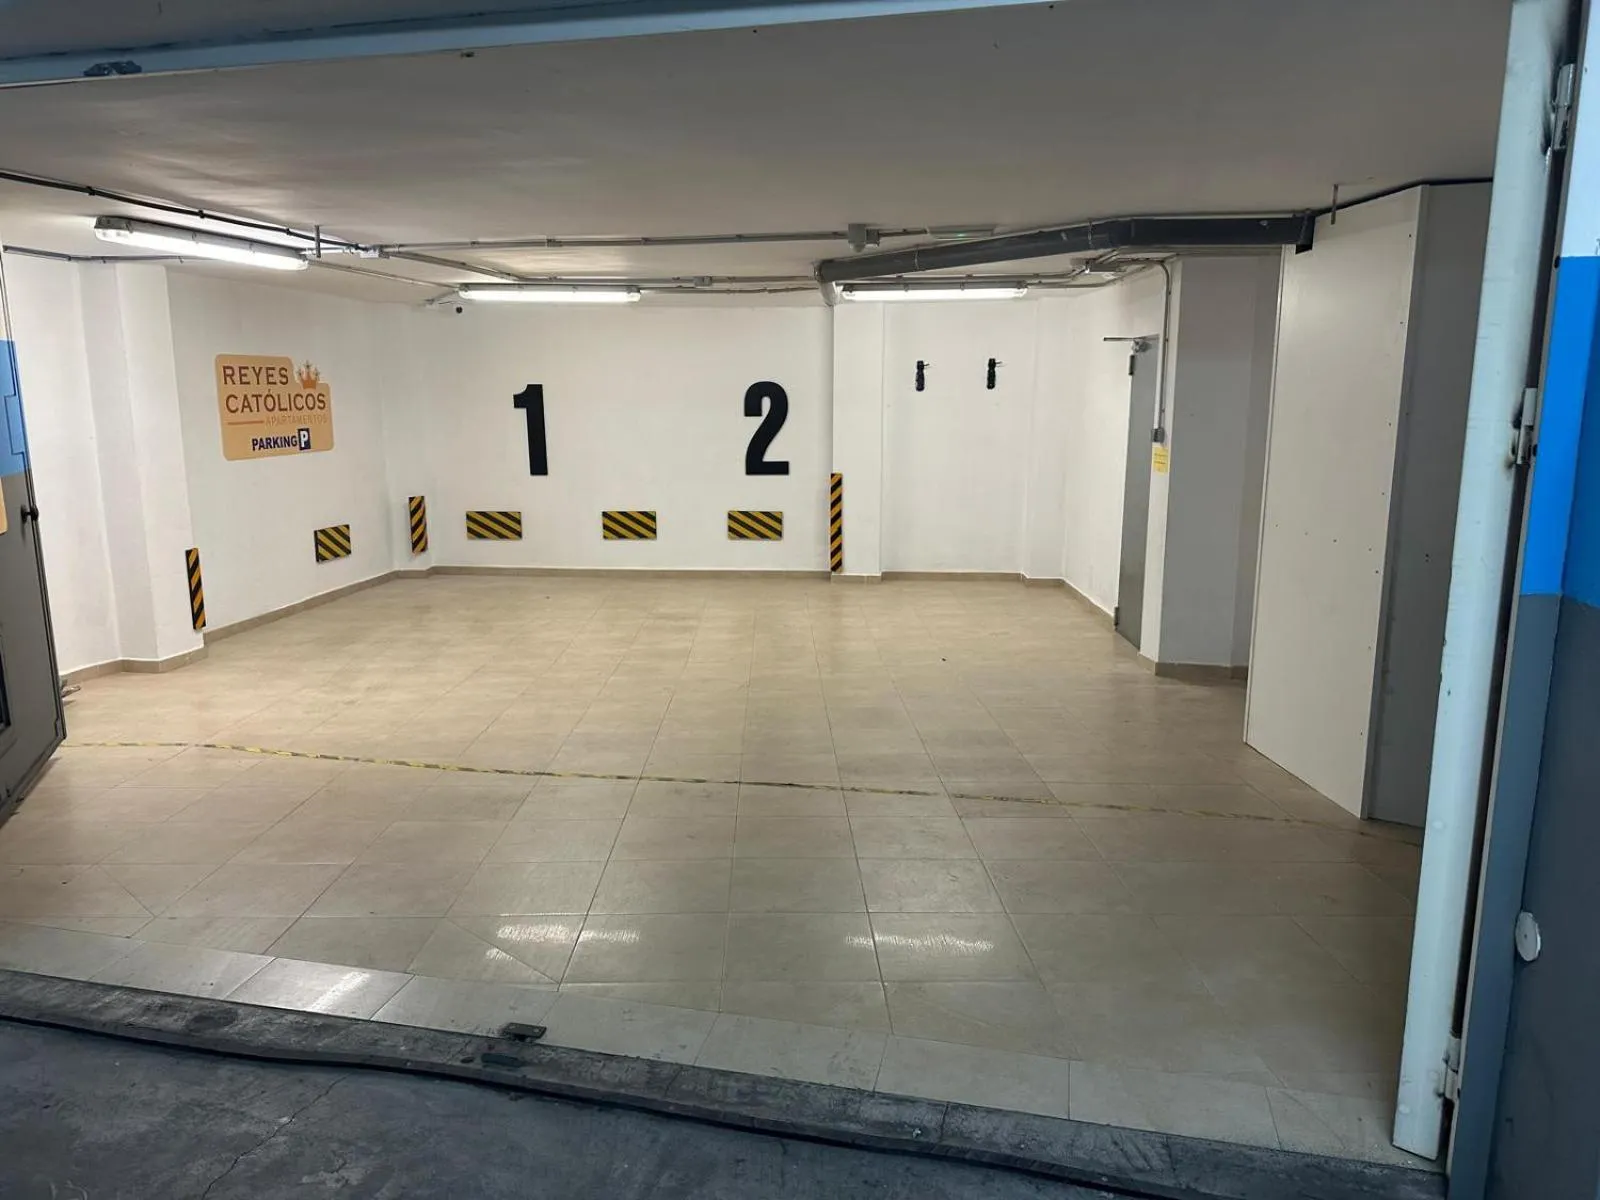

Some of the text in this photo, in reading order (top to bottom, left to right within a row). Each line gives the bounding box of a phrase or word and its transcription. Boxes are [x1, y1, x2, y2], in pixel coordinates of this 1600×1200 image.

[222, 365, 289, 386] REYES
[225, 388, 326, 413] CATÓLICOS
[252, 429, 309, 451] PARKING P
[513, 384, 548, 475] 1
[744, 382, 789, 475] 2
